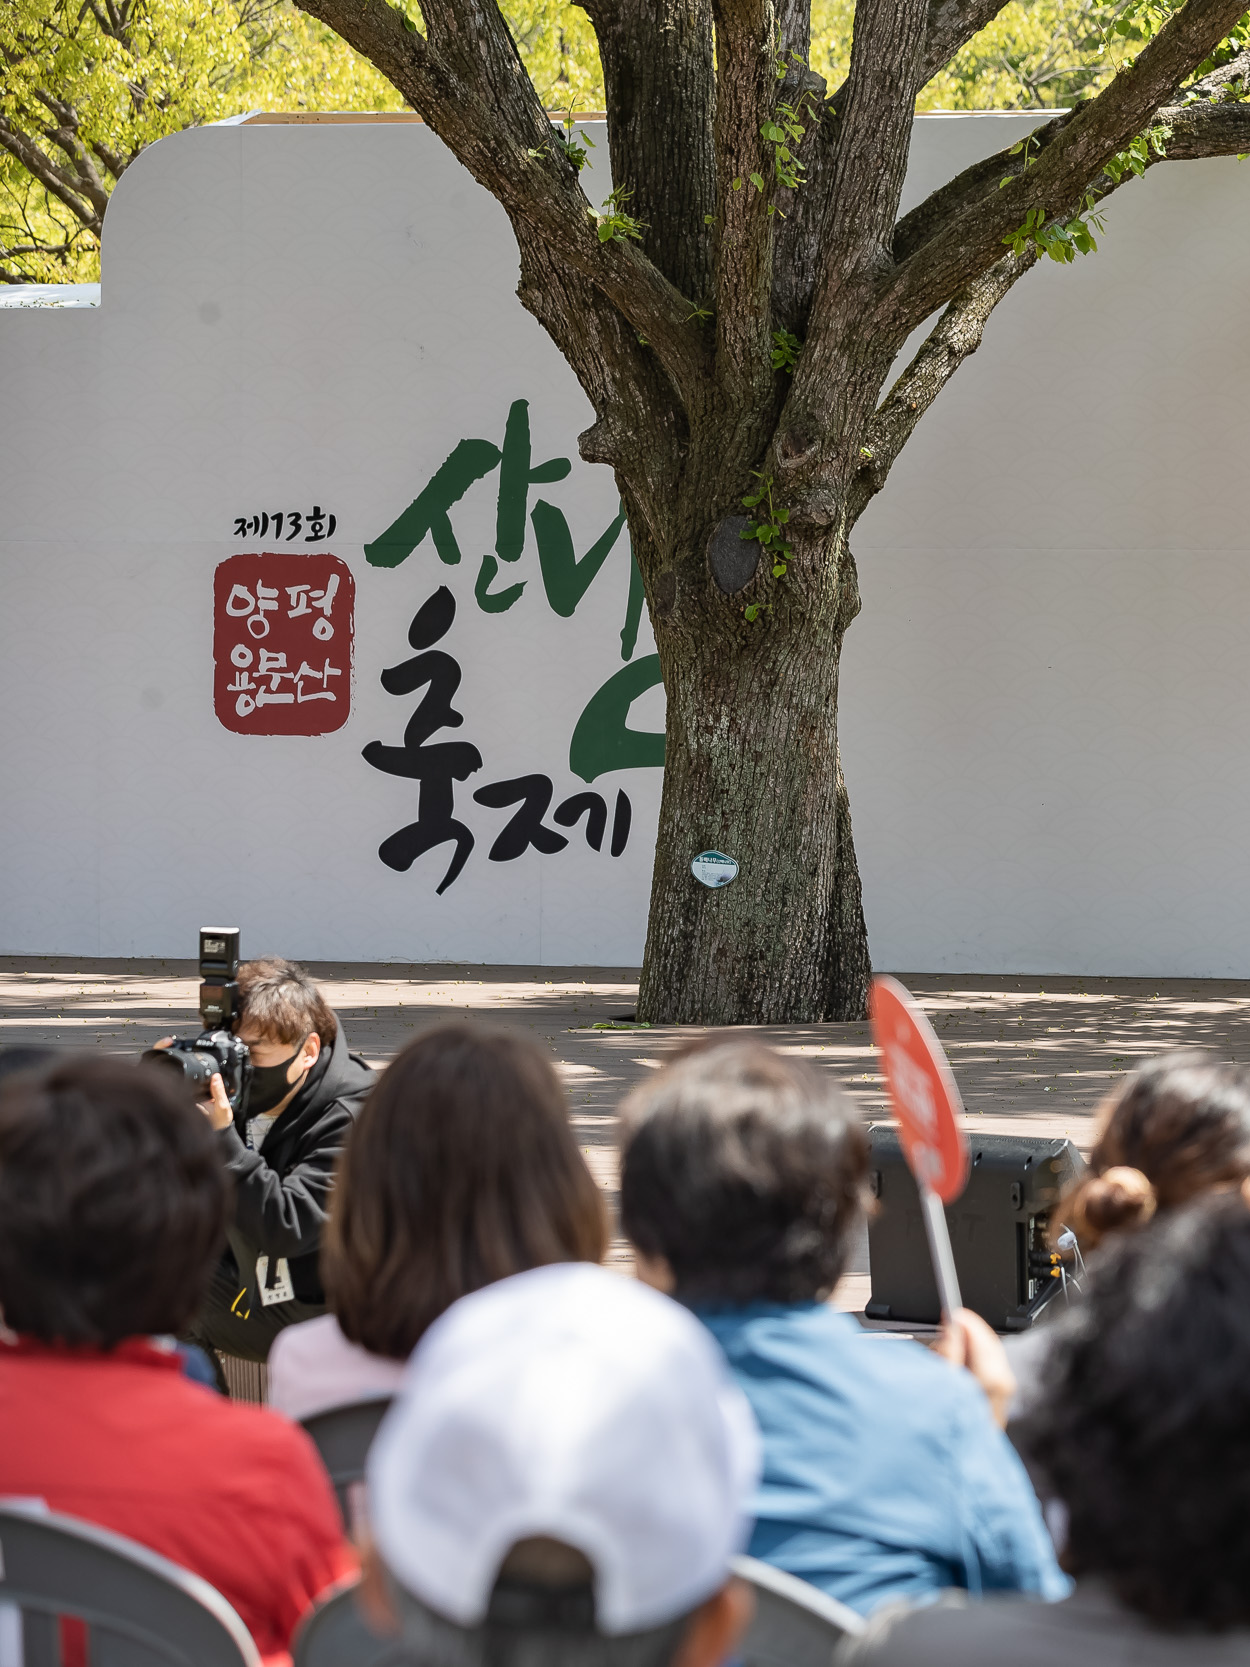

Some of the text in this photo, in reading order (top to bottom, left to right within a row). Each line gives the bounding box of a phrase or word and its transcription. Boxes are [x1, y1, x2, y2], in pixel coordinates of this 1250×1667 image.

[233, 505, 337, 542] 제13회
[225, 573, 341, 641] 양평
[363, 398, 667, 784] 산나
[226, 643, 342, 718] 용문산
[361, 585, 632, 896] 축제
